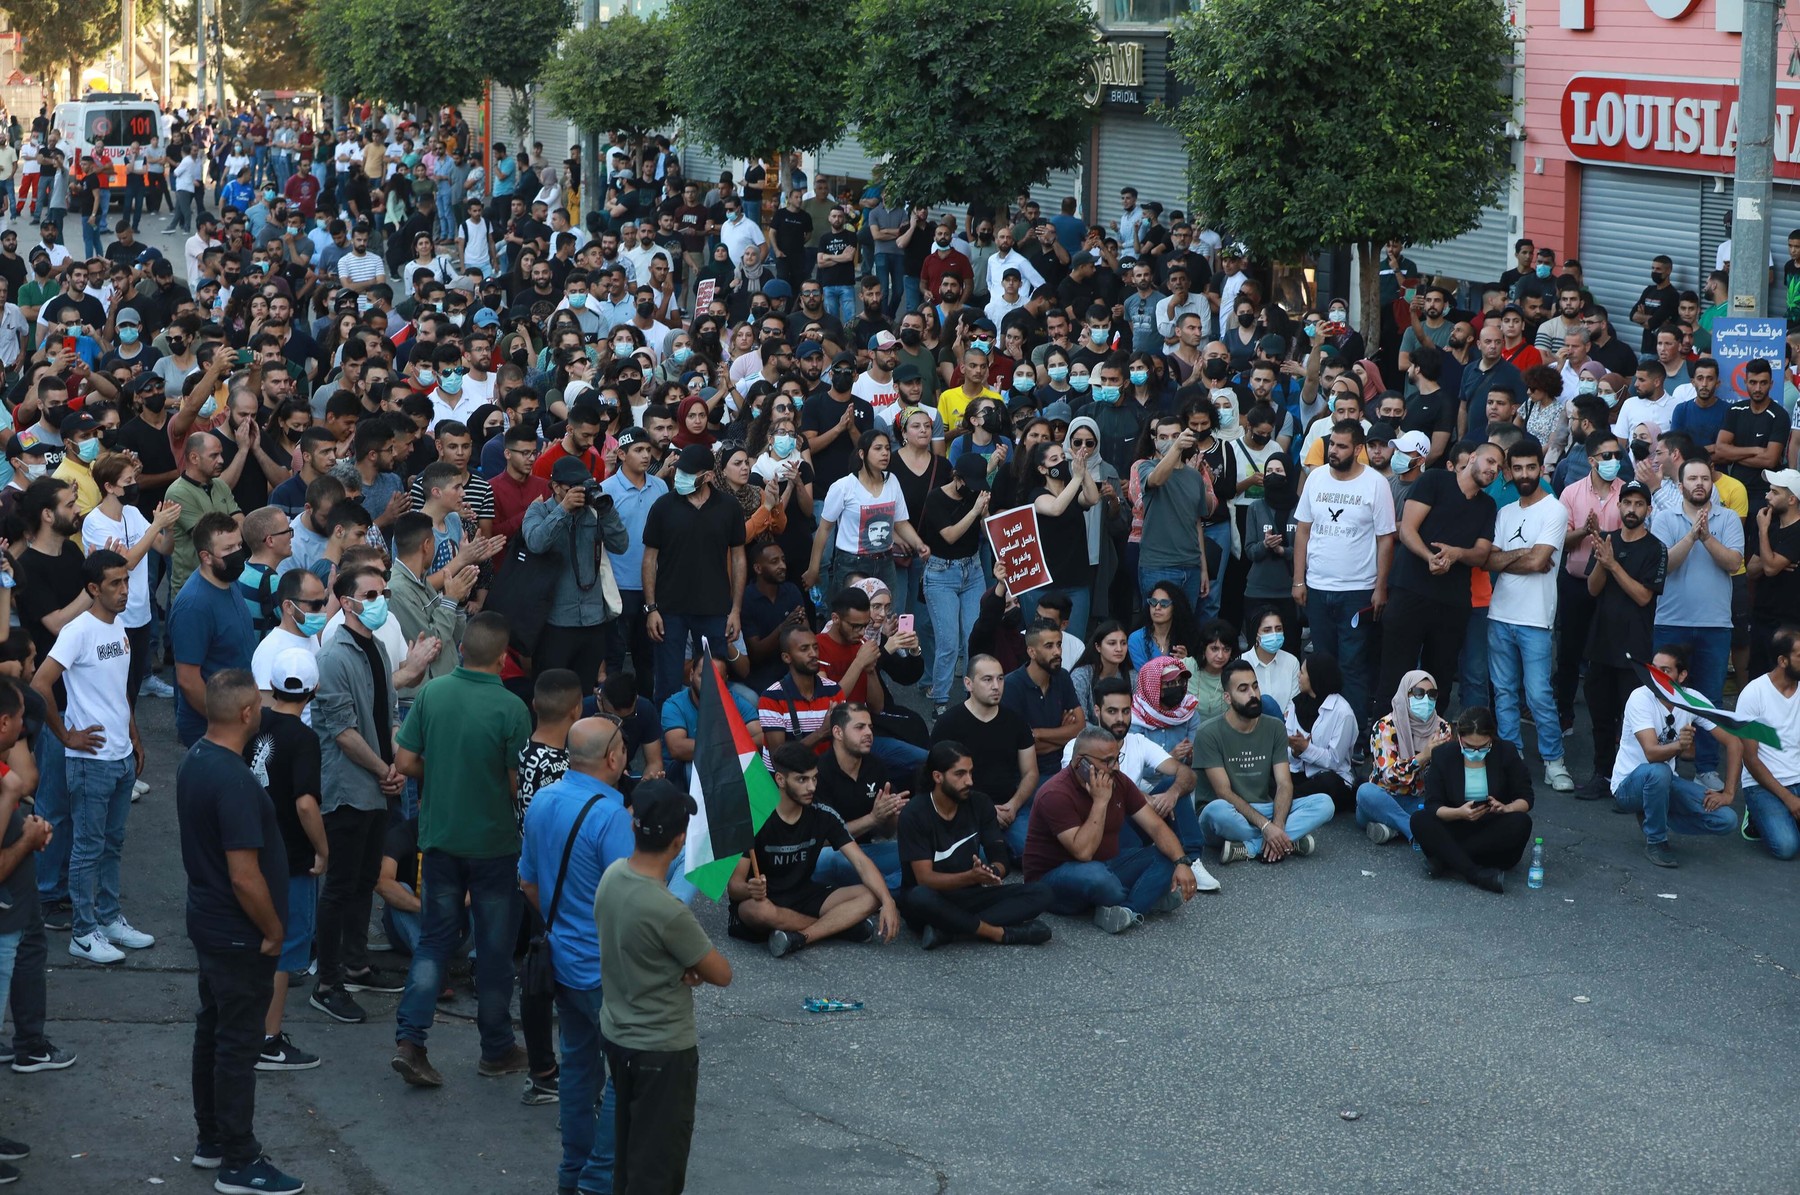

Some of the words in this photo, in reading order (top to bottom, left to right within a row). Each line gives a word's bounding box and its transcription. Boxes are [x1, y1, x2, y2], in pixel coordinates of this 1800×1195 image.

[1111, 90, 1139, 103] BRIDAL
[130, 117, 151, 135] 101
[1570, 91, 1800, 164] LOUISIAN
[1716, 323, 1748, 342] تكسي
[1750, 323, 1783, 340] موقف
[1719, 344, 1752, 359] الوقوف
[1753, 345, 1778, 359] ممنوع
[1315, 492, 1363, 506] AMERICAN
[999, 539, 1020, 558] السلمي
[1020, 533, 1036, 548] بالحل
[1008, 566, 1029, 584] الشوارع
[96, 641, 125, 661] KARL
[774, 851, 807, 865] NIKE
